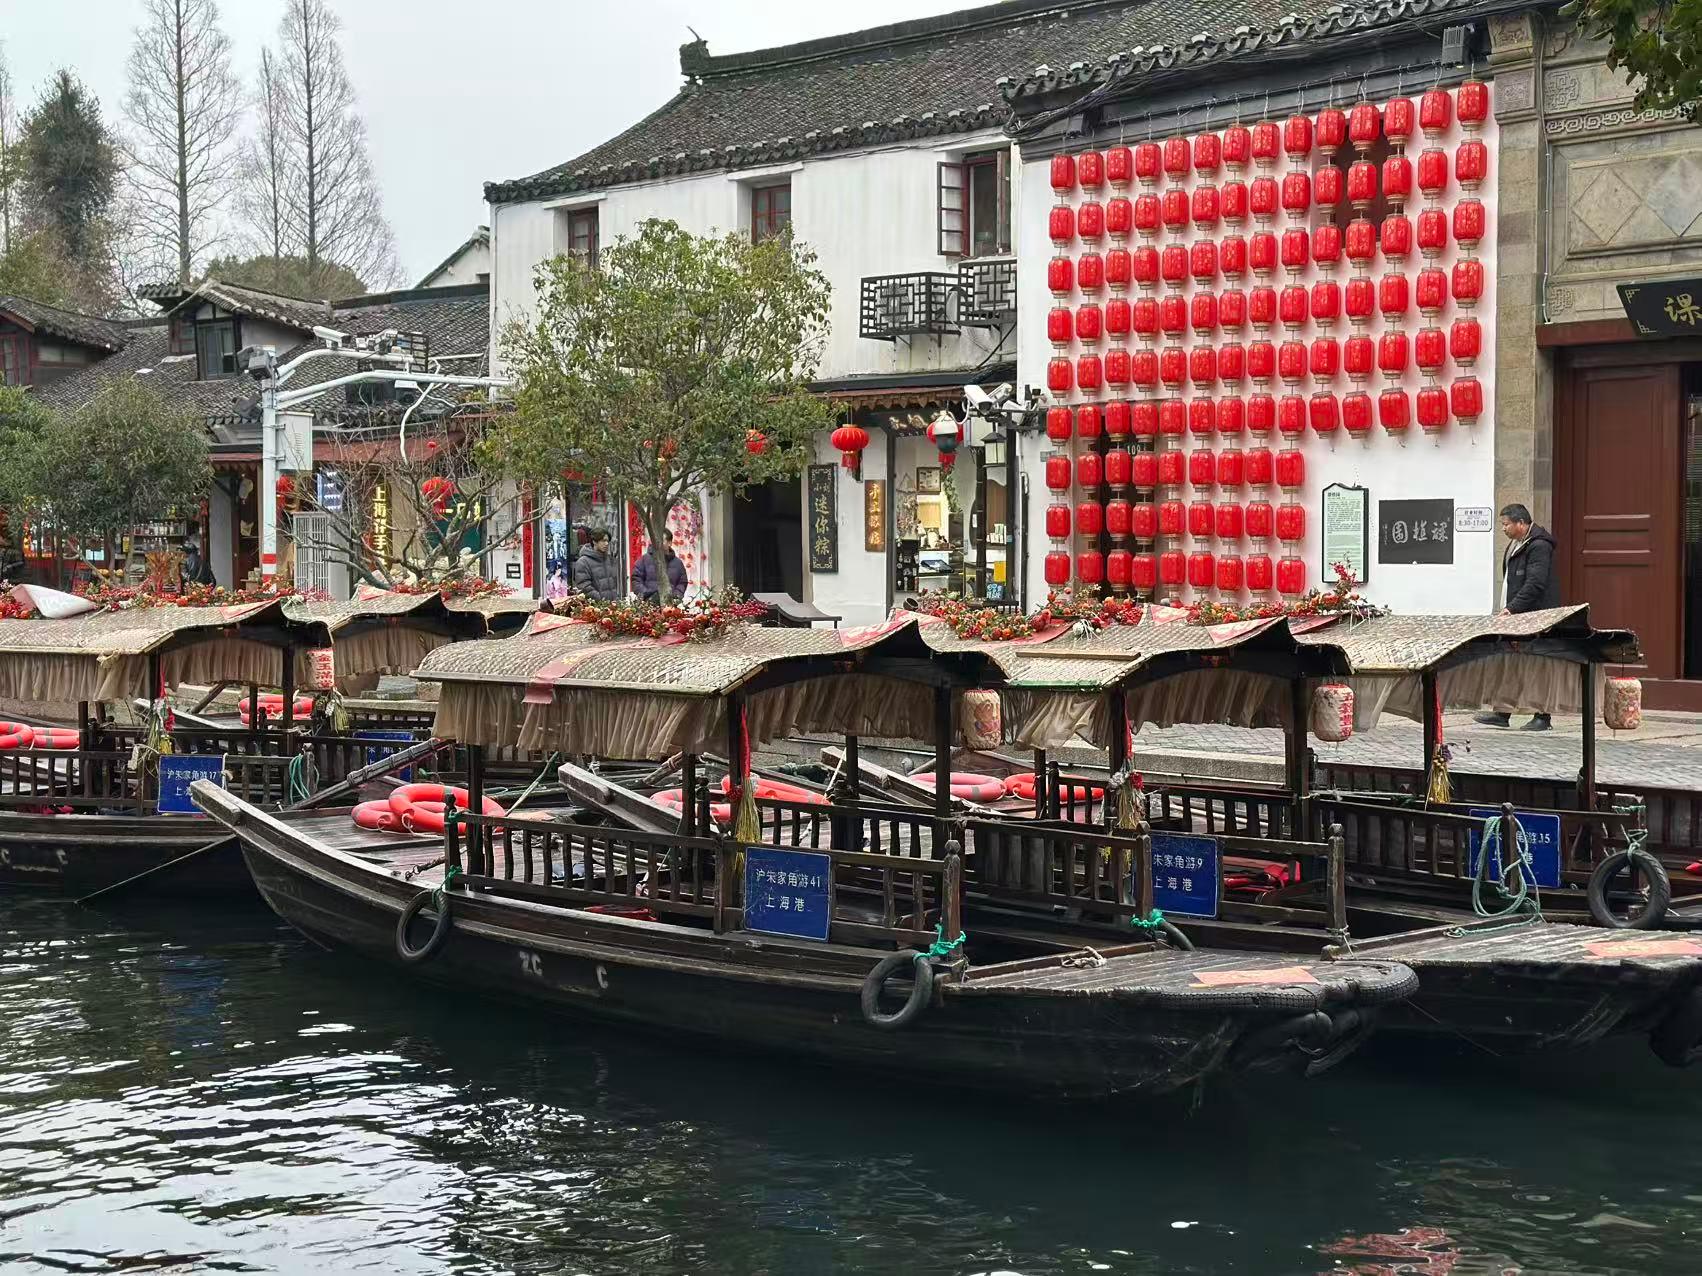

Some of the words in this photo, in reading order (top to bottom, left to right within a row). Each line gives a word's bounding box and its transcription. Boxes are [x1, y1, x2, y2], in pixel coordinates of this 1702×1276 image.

[755, 868, 821, 888] 沪朱家角游41
[765, 893, 805, 912] 上海港
